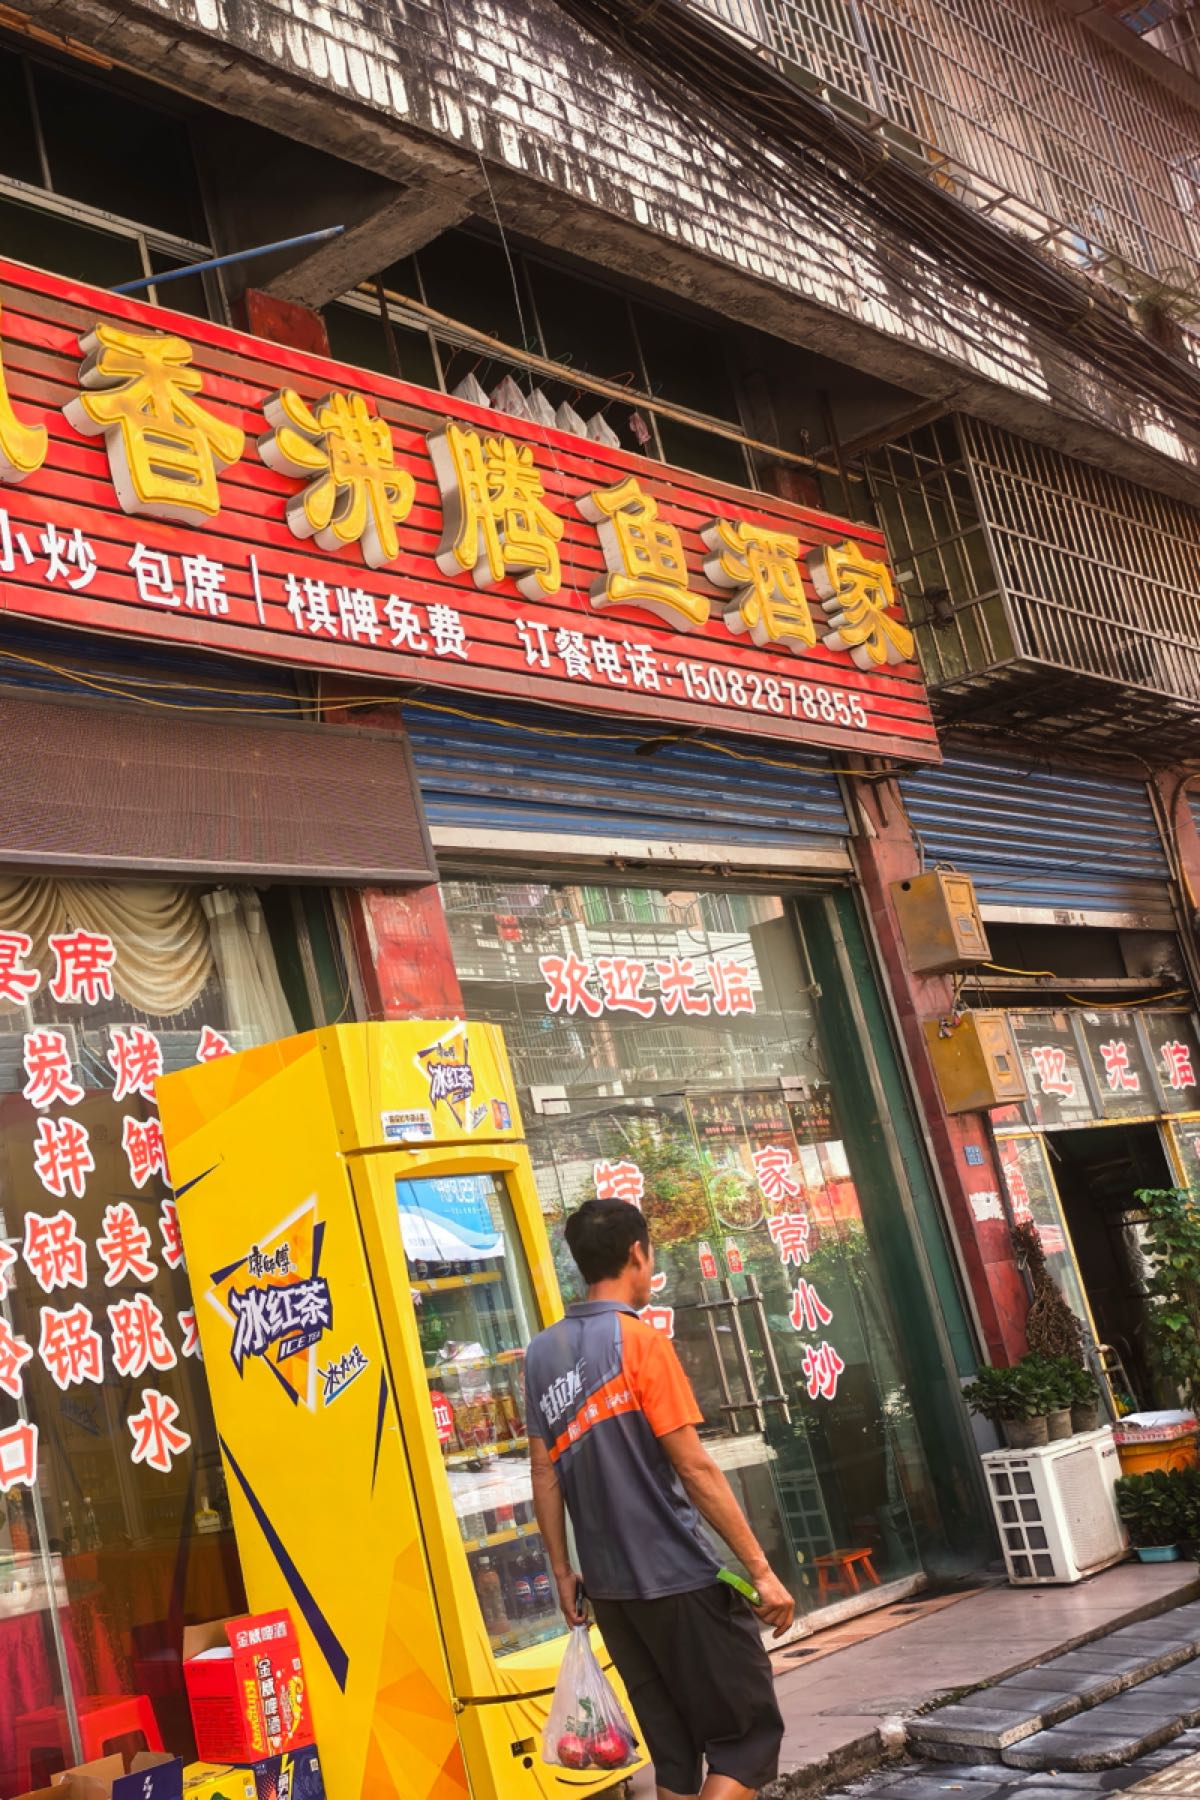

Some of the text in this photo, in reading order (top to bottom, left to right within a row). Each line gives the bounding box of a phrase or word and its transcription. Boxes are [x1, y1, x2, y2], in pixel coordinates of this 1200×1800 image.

[127, 543, 230, 617] 包席
[284, 573, 468, 660] 棋牌免费
[538, 952, 756, 1018] 欢迎光临
[753, 1145, 845, 1400] 家常小炒
[229, 1280, 331, 1370] 冰红茶
[280, 1336, 306, 1358] ICE
